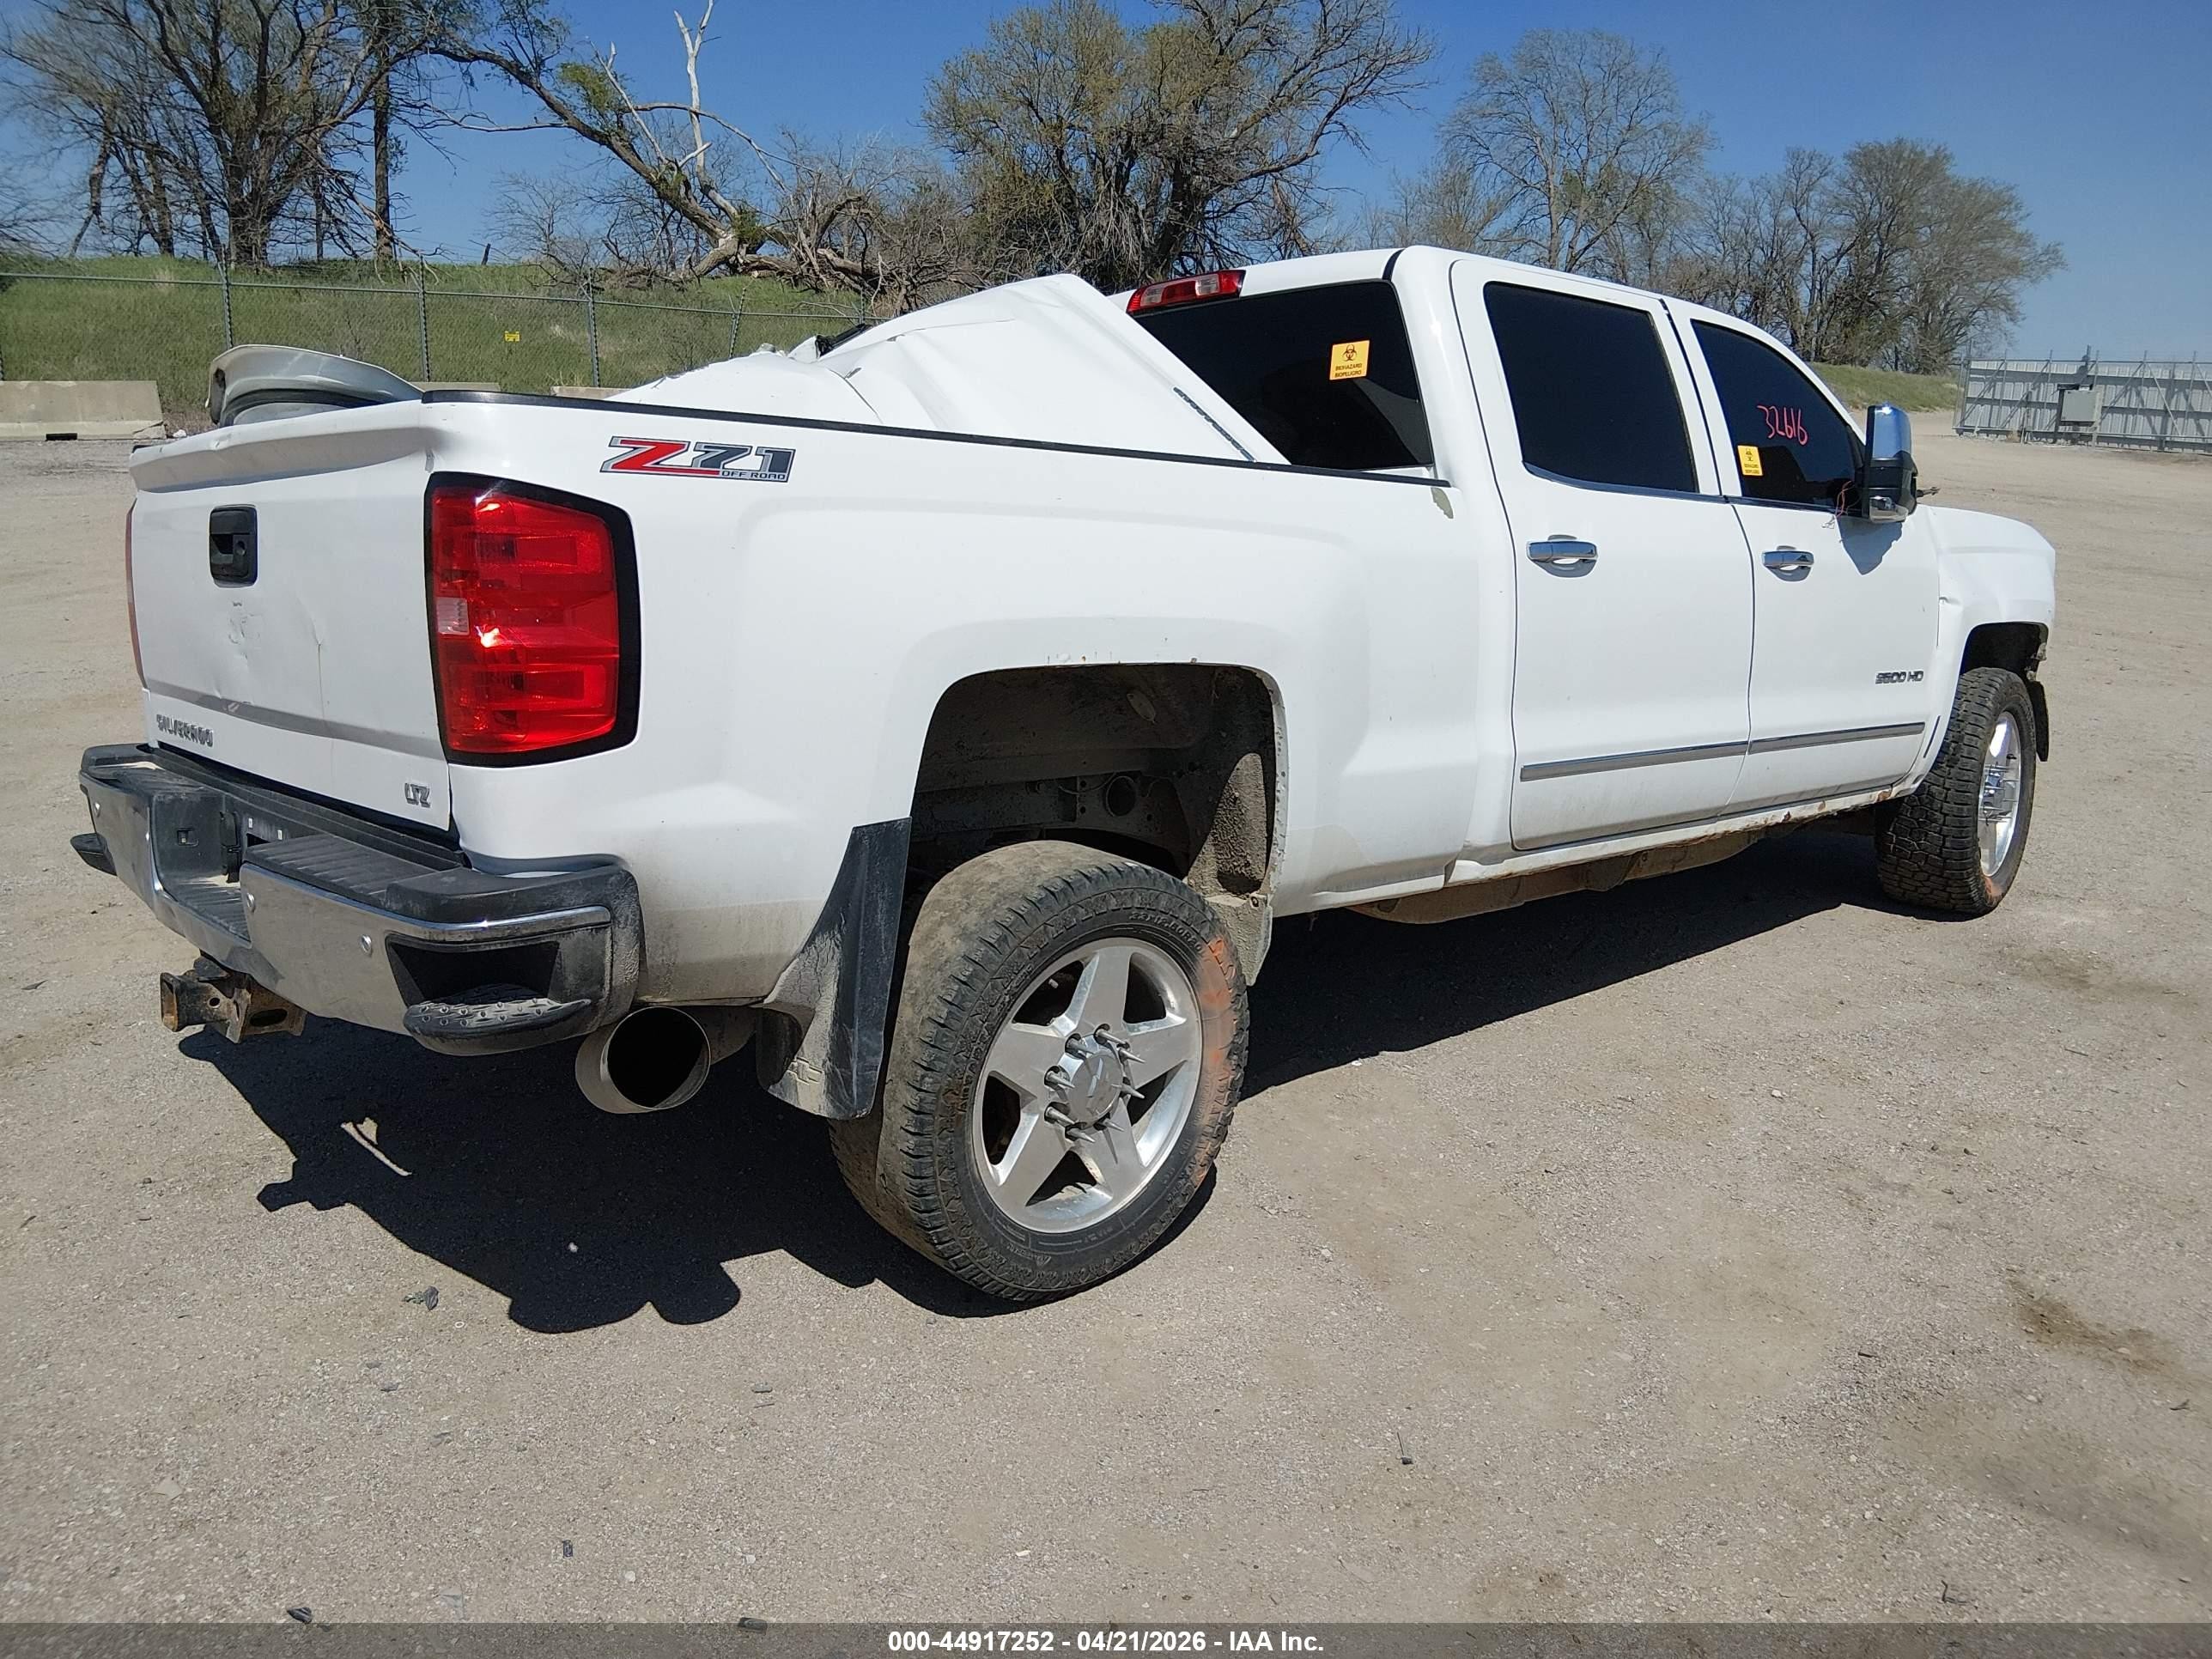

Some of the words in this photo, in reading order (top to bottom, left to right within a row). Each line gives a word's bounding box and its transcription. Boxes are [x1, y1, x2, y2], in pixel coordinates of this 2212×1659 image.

[599, 436, 797, 483] Z71
[1907, 671, 1924, 682] HD
[156, 714, 214, 748] SILVERADO
[404, 782, 431, 808] LTZ
